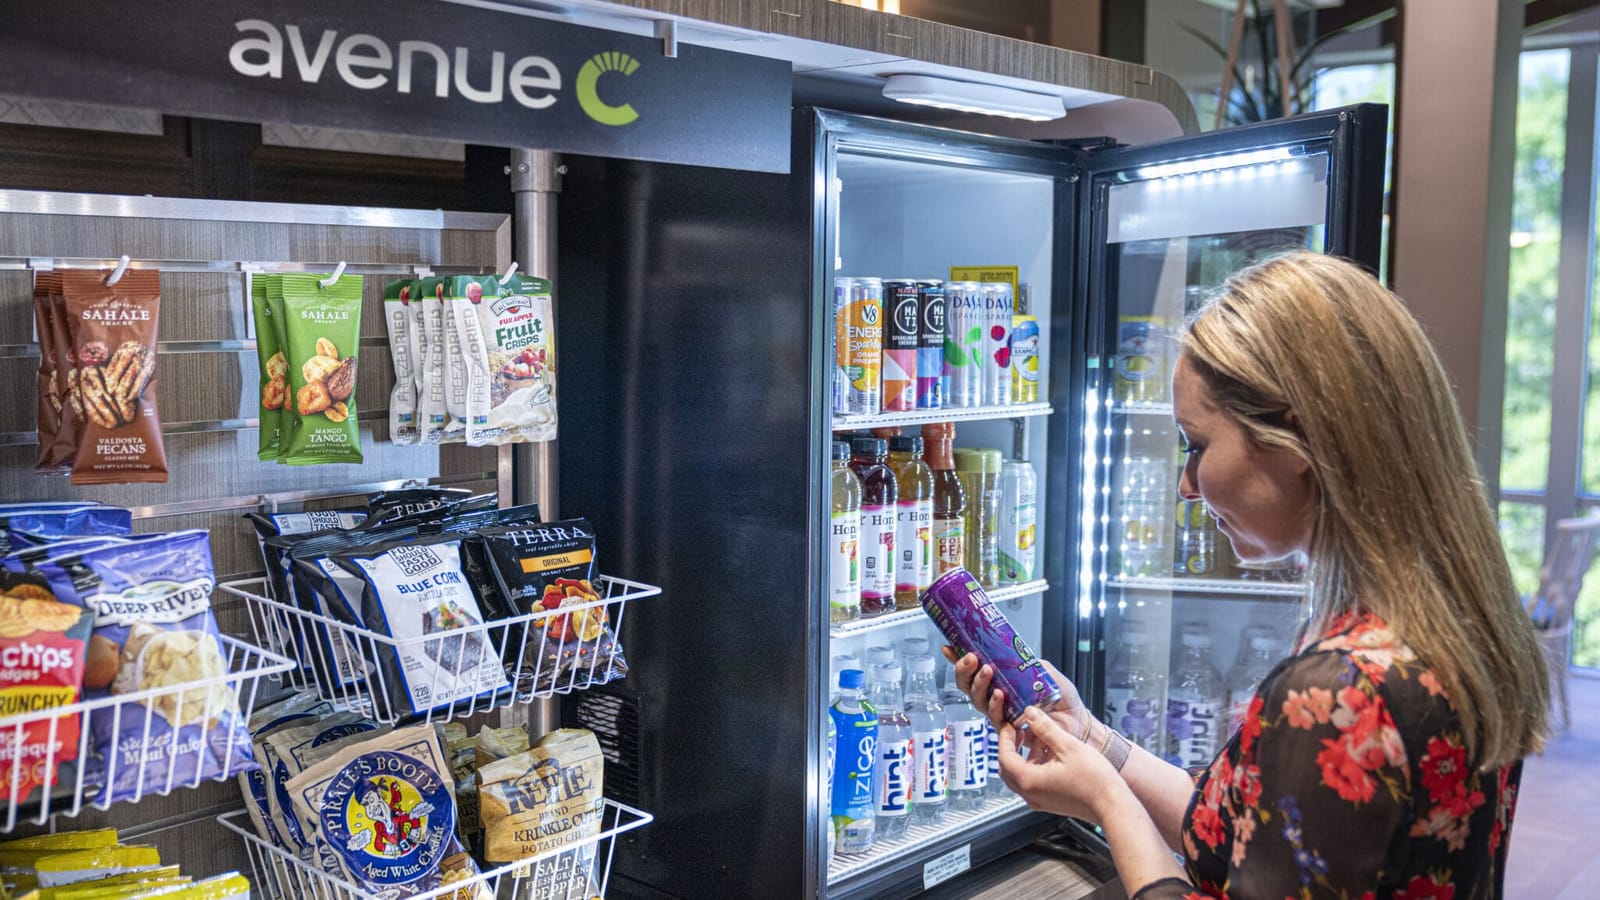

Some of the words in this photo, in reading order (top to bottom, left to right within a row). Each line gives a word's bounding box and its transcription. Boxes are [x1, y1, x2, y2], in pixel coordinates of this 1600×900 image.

[229, 19, 562, 109] avenue
[576, 51, 641, 126] C
[953, 295, 981, 310] DASA
[986, 296, 1012, 311] DASA
[82, 310, 151, 320] SAHALE
[301, 310, 349, 319] SAHALE
[514, 313, 533, 322] APPLE
[863, 304, 878, 322] V8
[496, 318, 543, 347] Fruit
[505, 334, 540, 351] CRISPS
[309, 434, 347, 442] TANGO
[96, 444, 146, 454] PECANS
[872, 514, 894, 525] Hon
[910, 511, 930, 521] Hon
[506, 526, 587, 546] TERRA
[833, 524, 856, 535] Hon
[395, 547, 428, 561] SHOULD
[939, 544, 962, 557] PEA
[400, 552, 432, 568] TASTE
[405, 557, 437, 574] GOOD
[543, 556, 571, 567] ORIGINAL
[396, 579, 433, 594] BLUE
[433, 572, 461, 585] CORN
[94, 600, 148, 617] DEEP
[415, 686, 429, 697] 220
[0, 694, 68, 714] RUNCHY
[166, 738, 204, 756] Onio
[964, 723, 984, 785] hint
[853, 735, 875, 795] zico
[924, 734, 945, 797] hint
[882, 747, 906, 811] hint
[326, 757, 372, 830] PIRATE'S
[376, 757, 437, 792] BOOTY
[539, 805, 569, 821] BRAND
[514, 818, 572, 841] KRINKLE
[521, 837, 563, 854] POTATO
[363, 862, 388, 878] Aged
[390, 864, 421, 878] White
[538, 856, 571, 877] SALT
[534, 876, 585, 899] PEPPER
